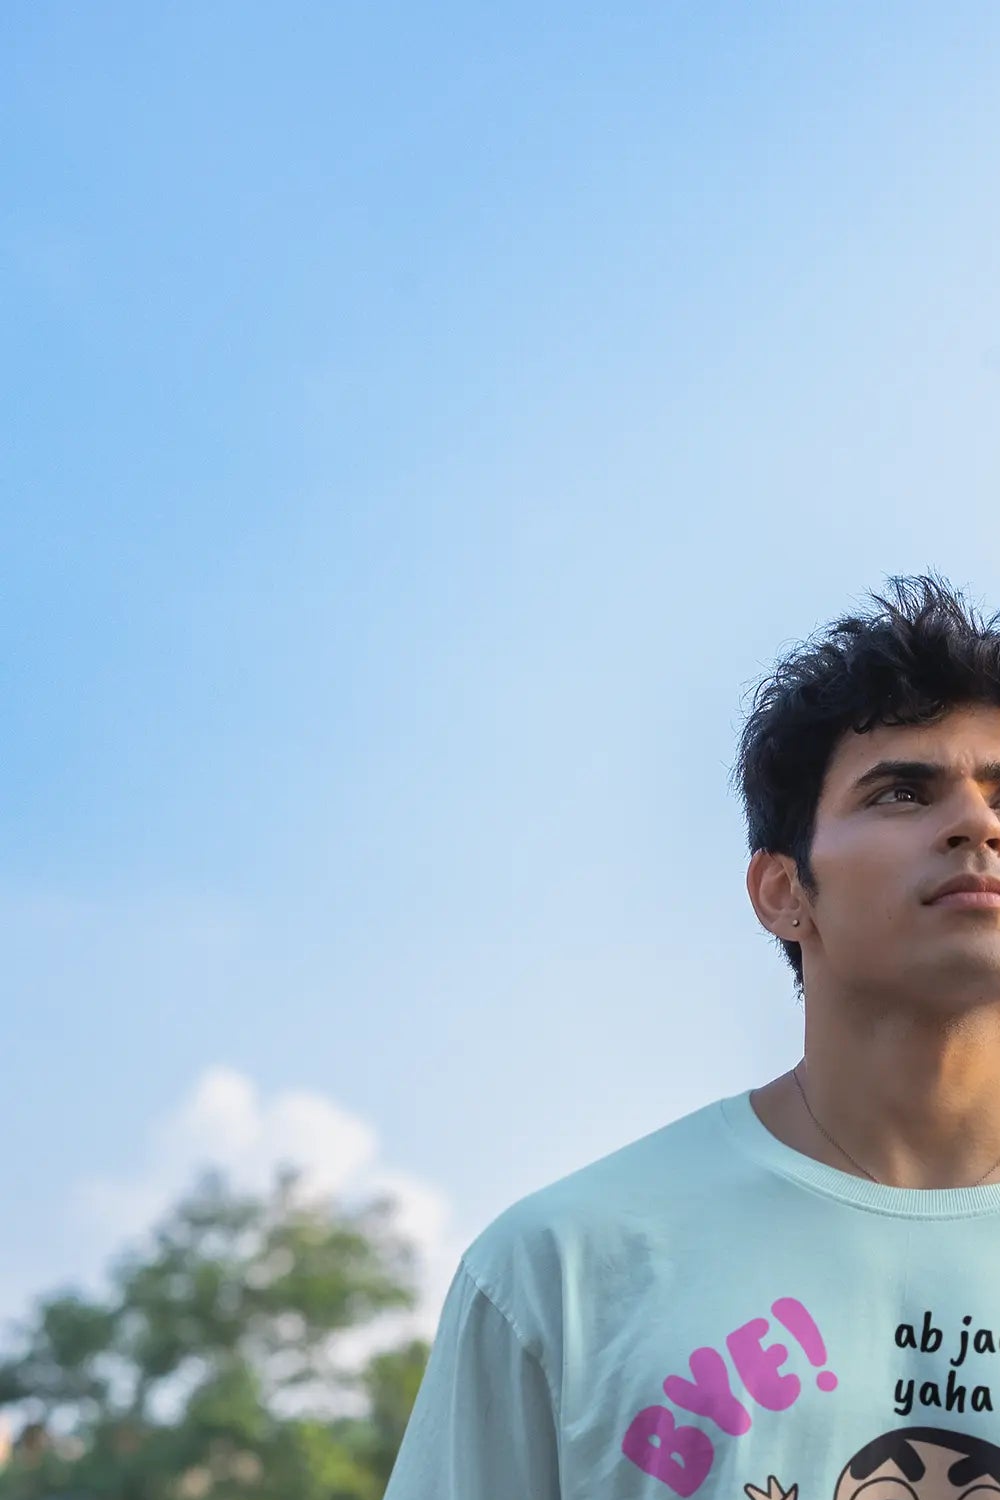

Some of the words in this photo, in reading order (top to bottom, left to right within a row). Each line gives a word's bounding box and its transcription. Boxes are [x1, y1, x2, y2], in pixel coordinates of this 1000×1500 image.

[894, 1311, 943, 1354] ab
[621, 1297, 839, 1498] BYE!
[894, 1369, 993, 1417] yaha
